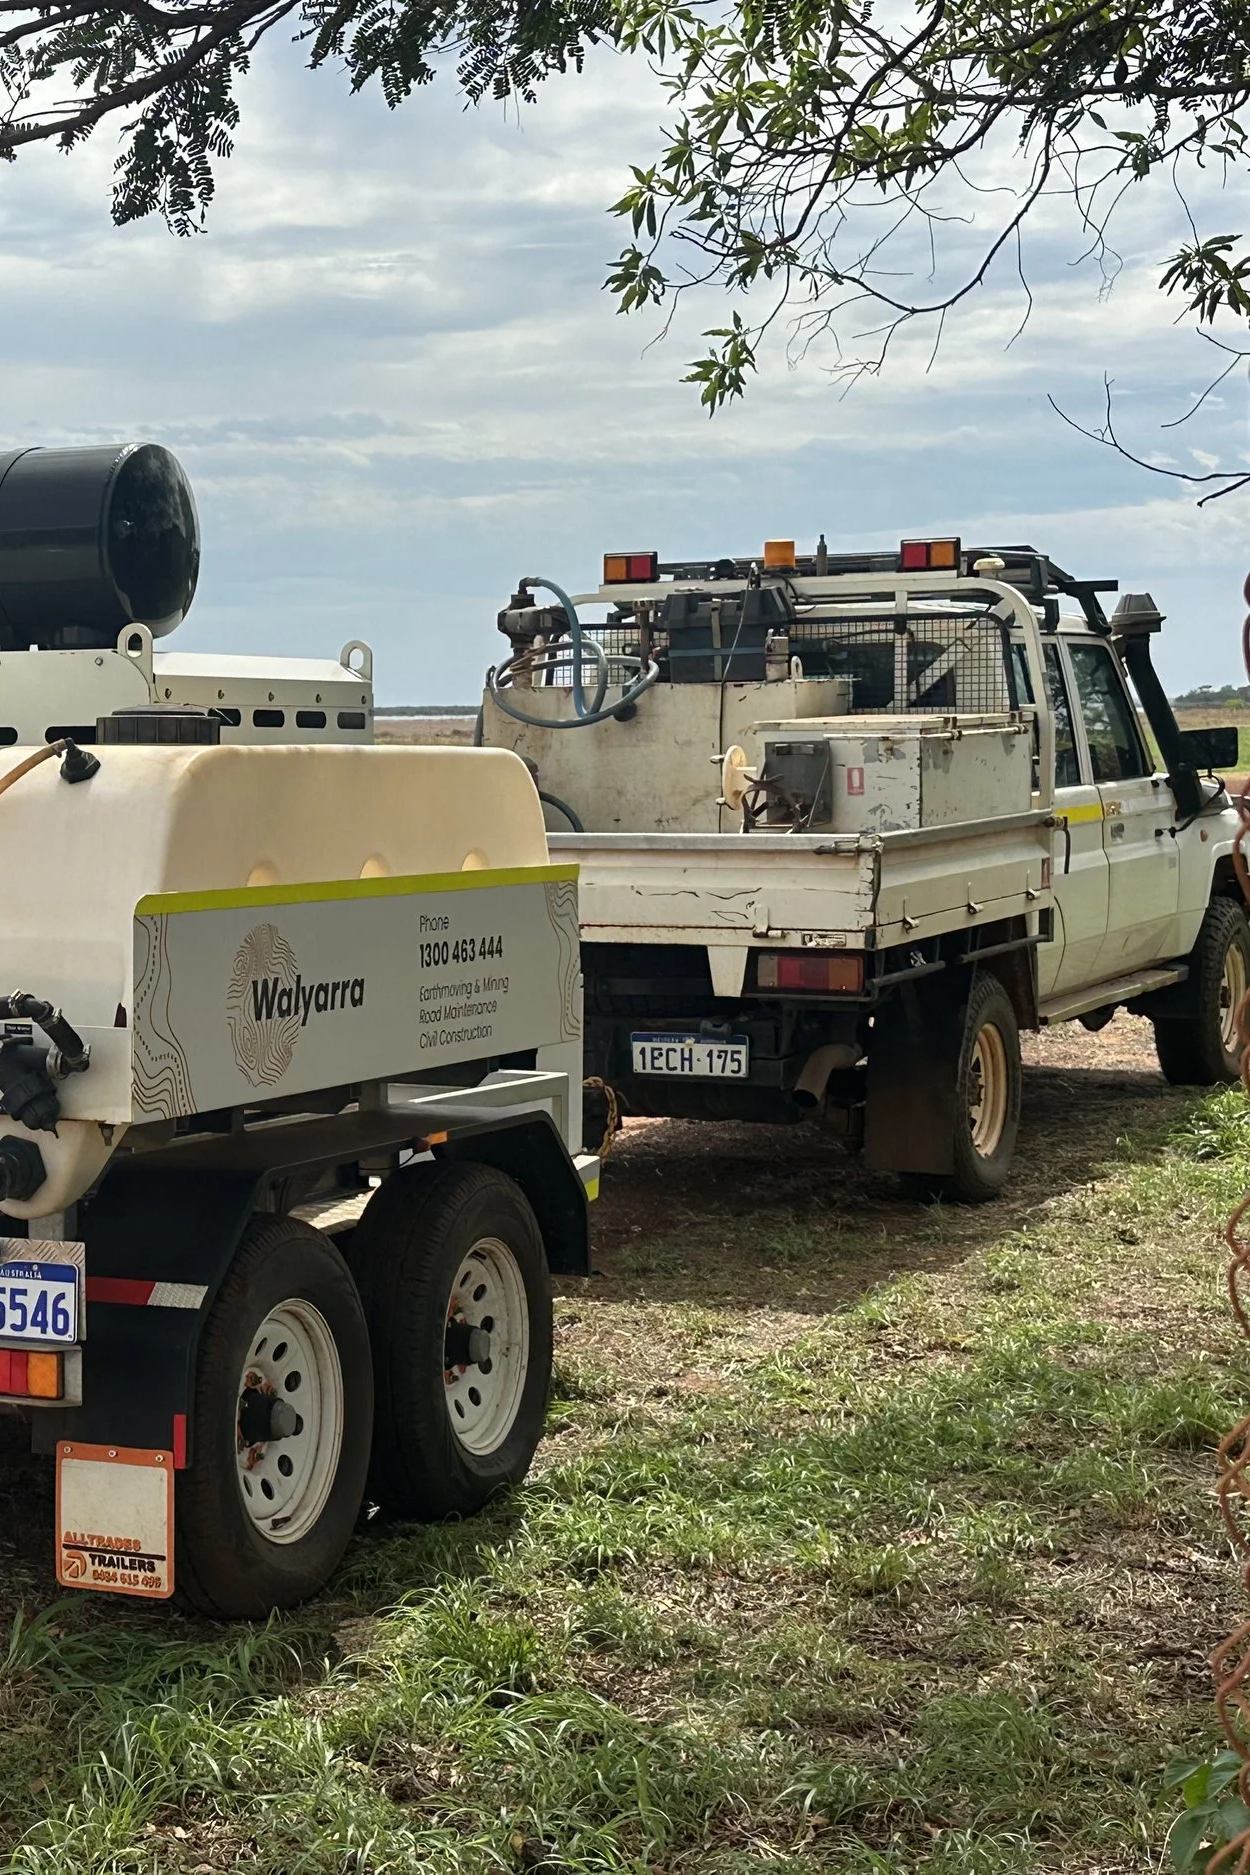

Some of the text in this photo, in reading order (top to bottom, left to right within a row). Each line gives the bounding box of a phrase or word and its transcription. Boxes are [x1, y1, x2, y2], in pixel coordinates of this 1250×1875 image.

[419, 914, 450, 932] Phone
[419, 935, 503, 968] 1300 463 444
[252, 974, 365, 1027] Walyarra
[419, 981, 473, 1002] Earthmoving
[483, 976, 509, 994] Mining
[419, 1000, 497, 1024] Road Maintenance
[419, 1024, 493, 1048] Civil Construction
[0, 1268, 42, 1280] AUSTRALIA
[63, 1531, 141, 1552] ALLTRADES
[88, 1553, 156, 1574] TRAILERS
